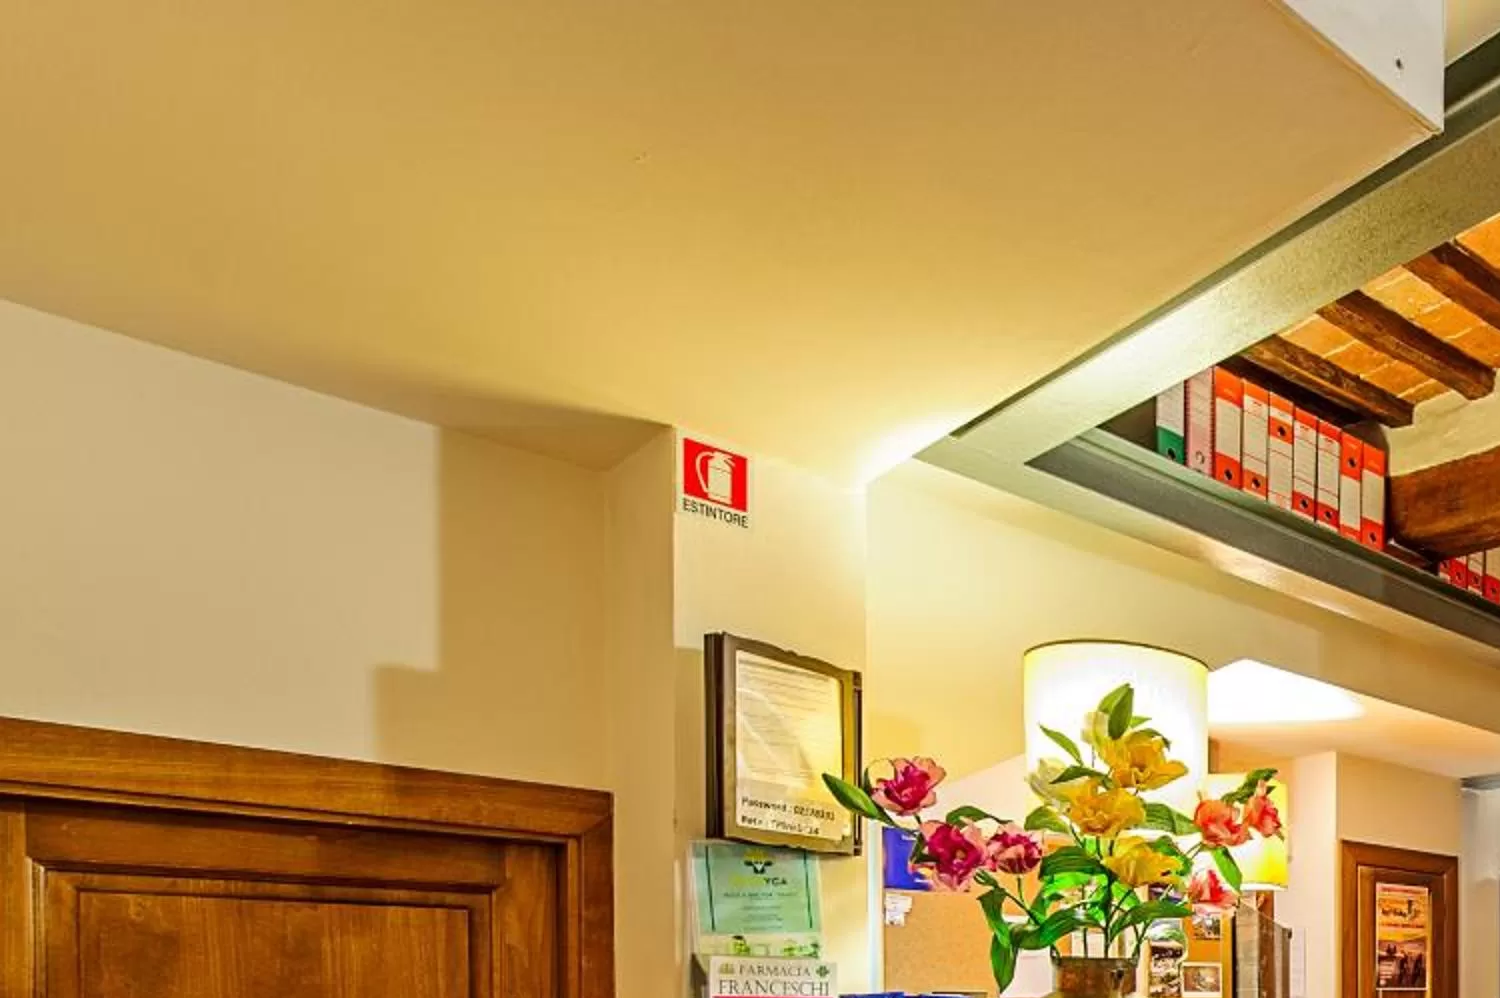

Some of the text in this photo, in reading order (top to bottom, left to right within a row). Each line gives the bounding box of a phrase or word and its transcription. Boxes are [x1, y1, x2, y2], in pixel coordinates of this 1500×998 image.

[683, 498, 748, 528] ESTINTORE
[739, 964, 811, 977] FARMACIA
[719, 979, 829, 996] FRANCESCHI
